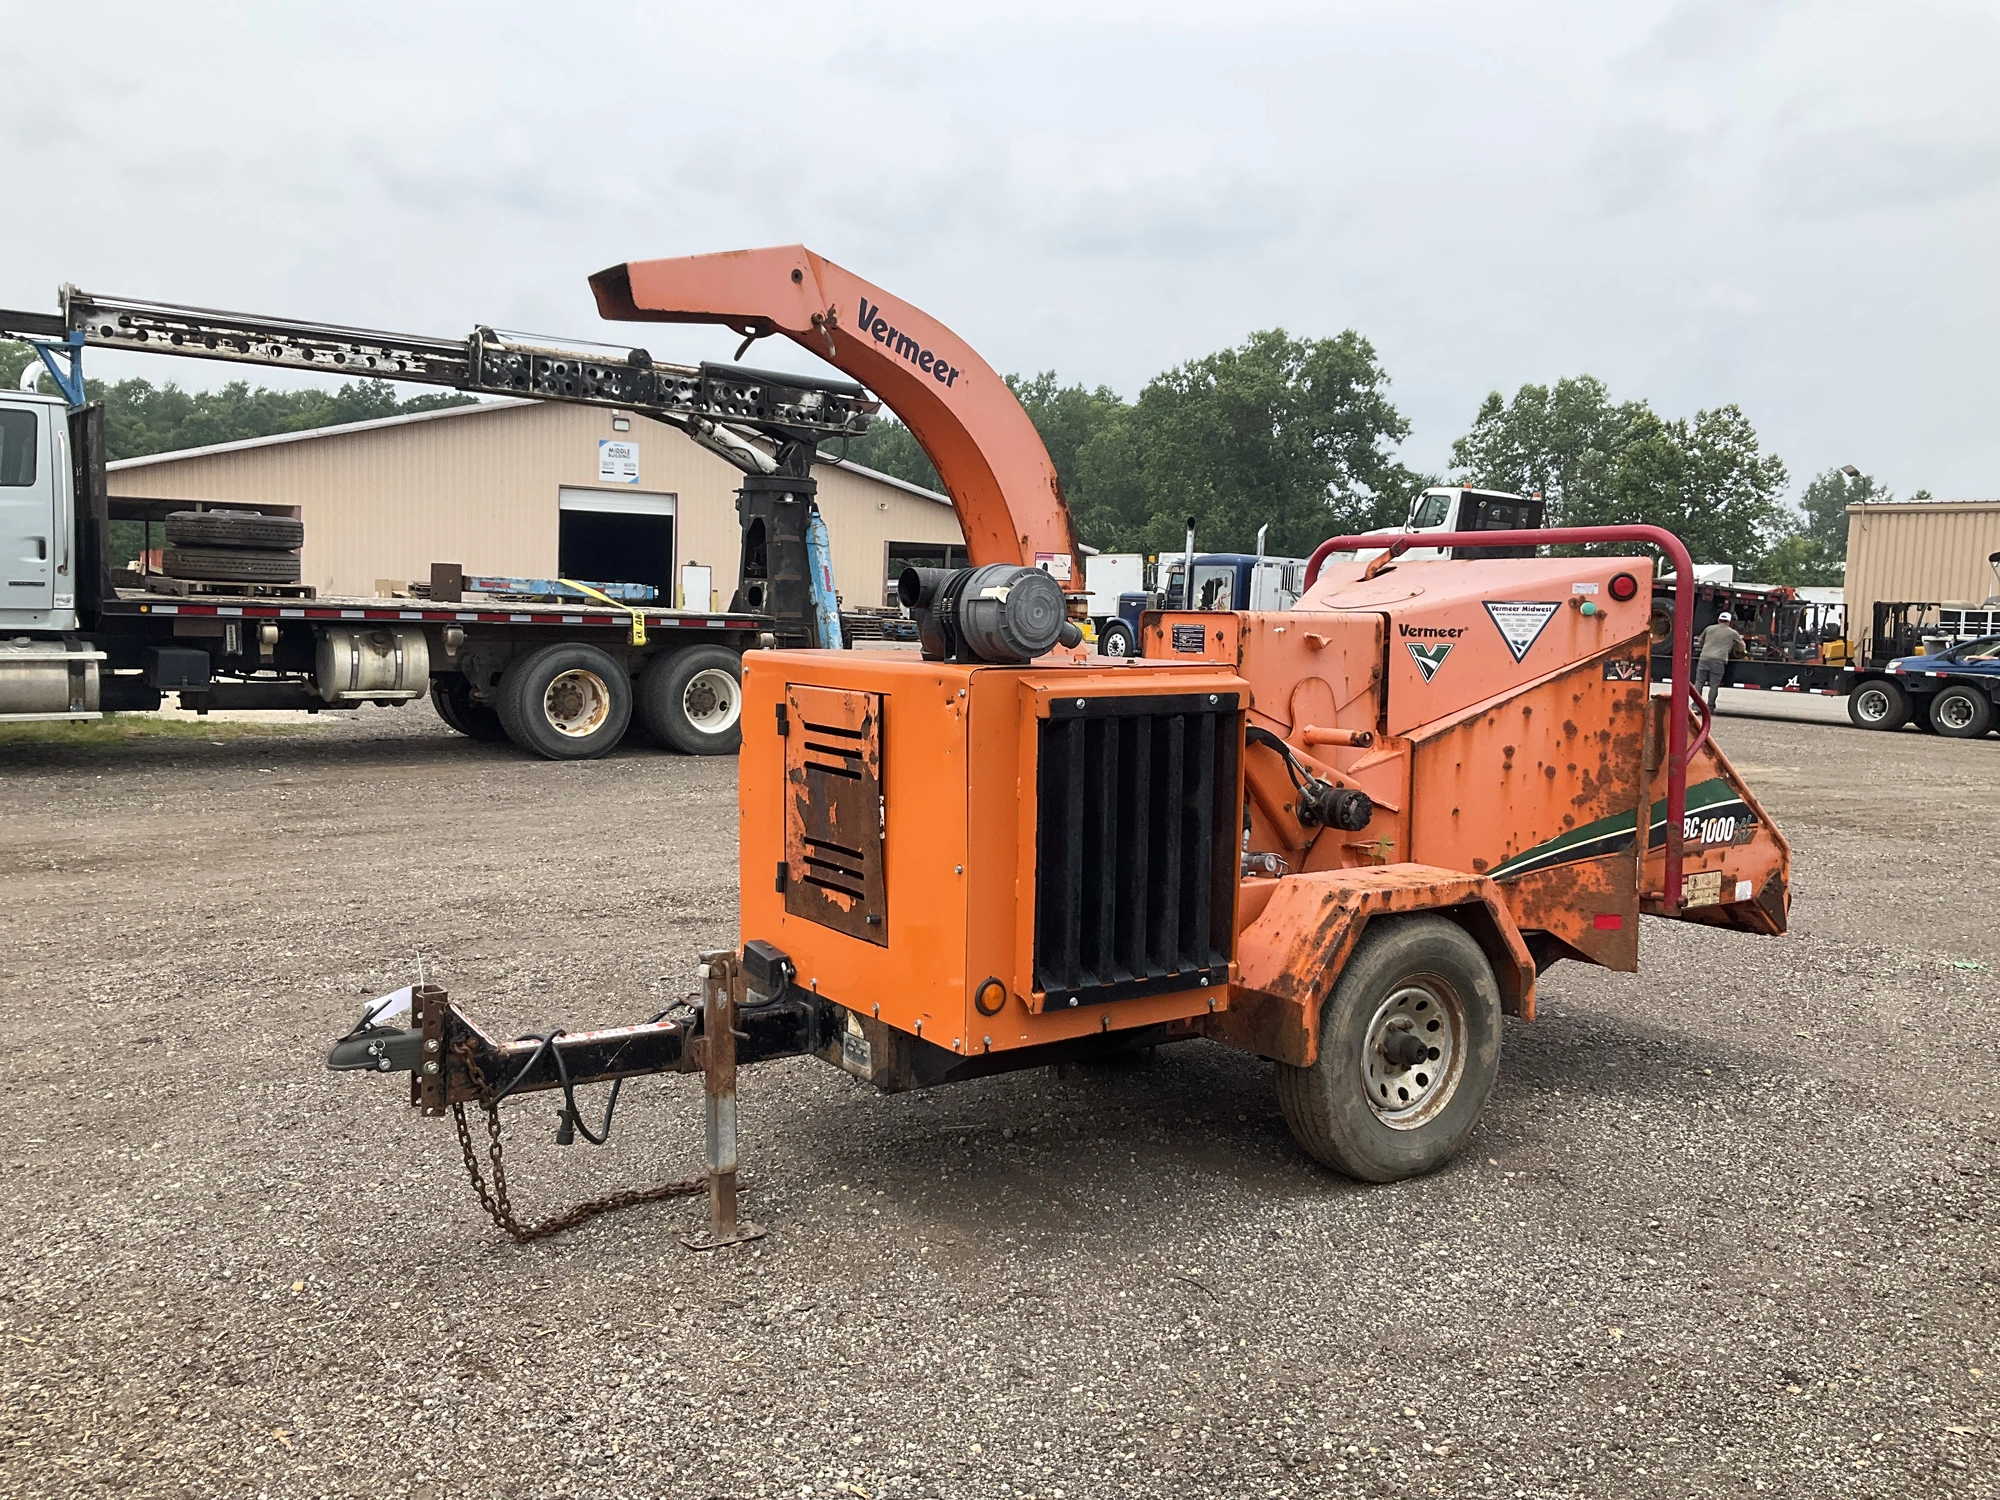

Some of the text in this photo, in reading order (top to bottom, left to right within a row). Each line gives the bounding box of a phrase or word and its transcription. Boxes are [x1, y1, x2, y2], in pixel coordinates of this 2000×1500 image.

[858, 296, 960, 388] Vermeer
[608, 447, 631, 455] MIDDLE
[1398, 623, 1464, 638] Vermeer
[1683, 816, 1700, 839] BC
[1700, 816, 1736, 844] 1000
